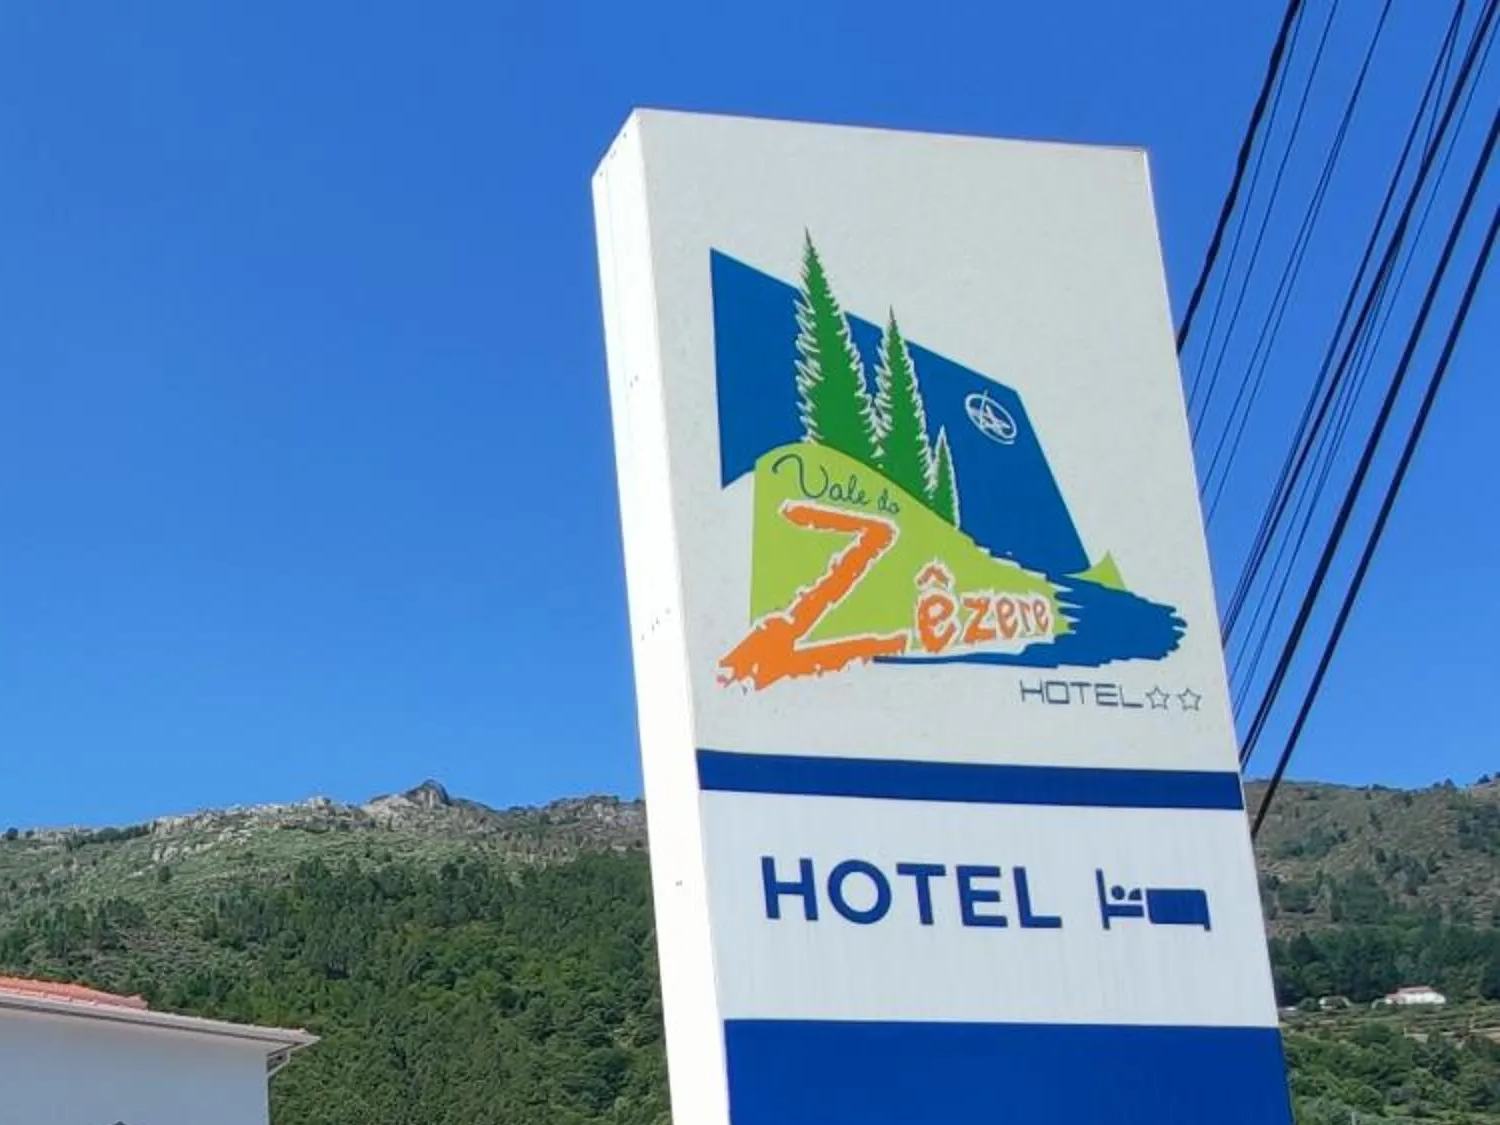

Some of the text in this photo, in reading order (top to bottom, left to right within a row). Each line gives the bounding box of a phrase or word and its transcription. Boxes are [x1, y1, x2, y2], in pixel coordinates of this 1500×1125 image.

[771, 453, 900, 516] Vale do
[717, 505, 1050, 691] Zêzere
[1019, 679, 1144, 709] HOTEL
[761, 856, 1062, 929] HOTEL
